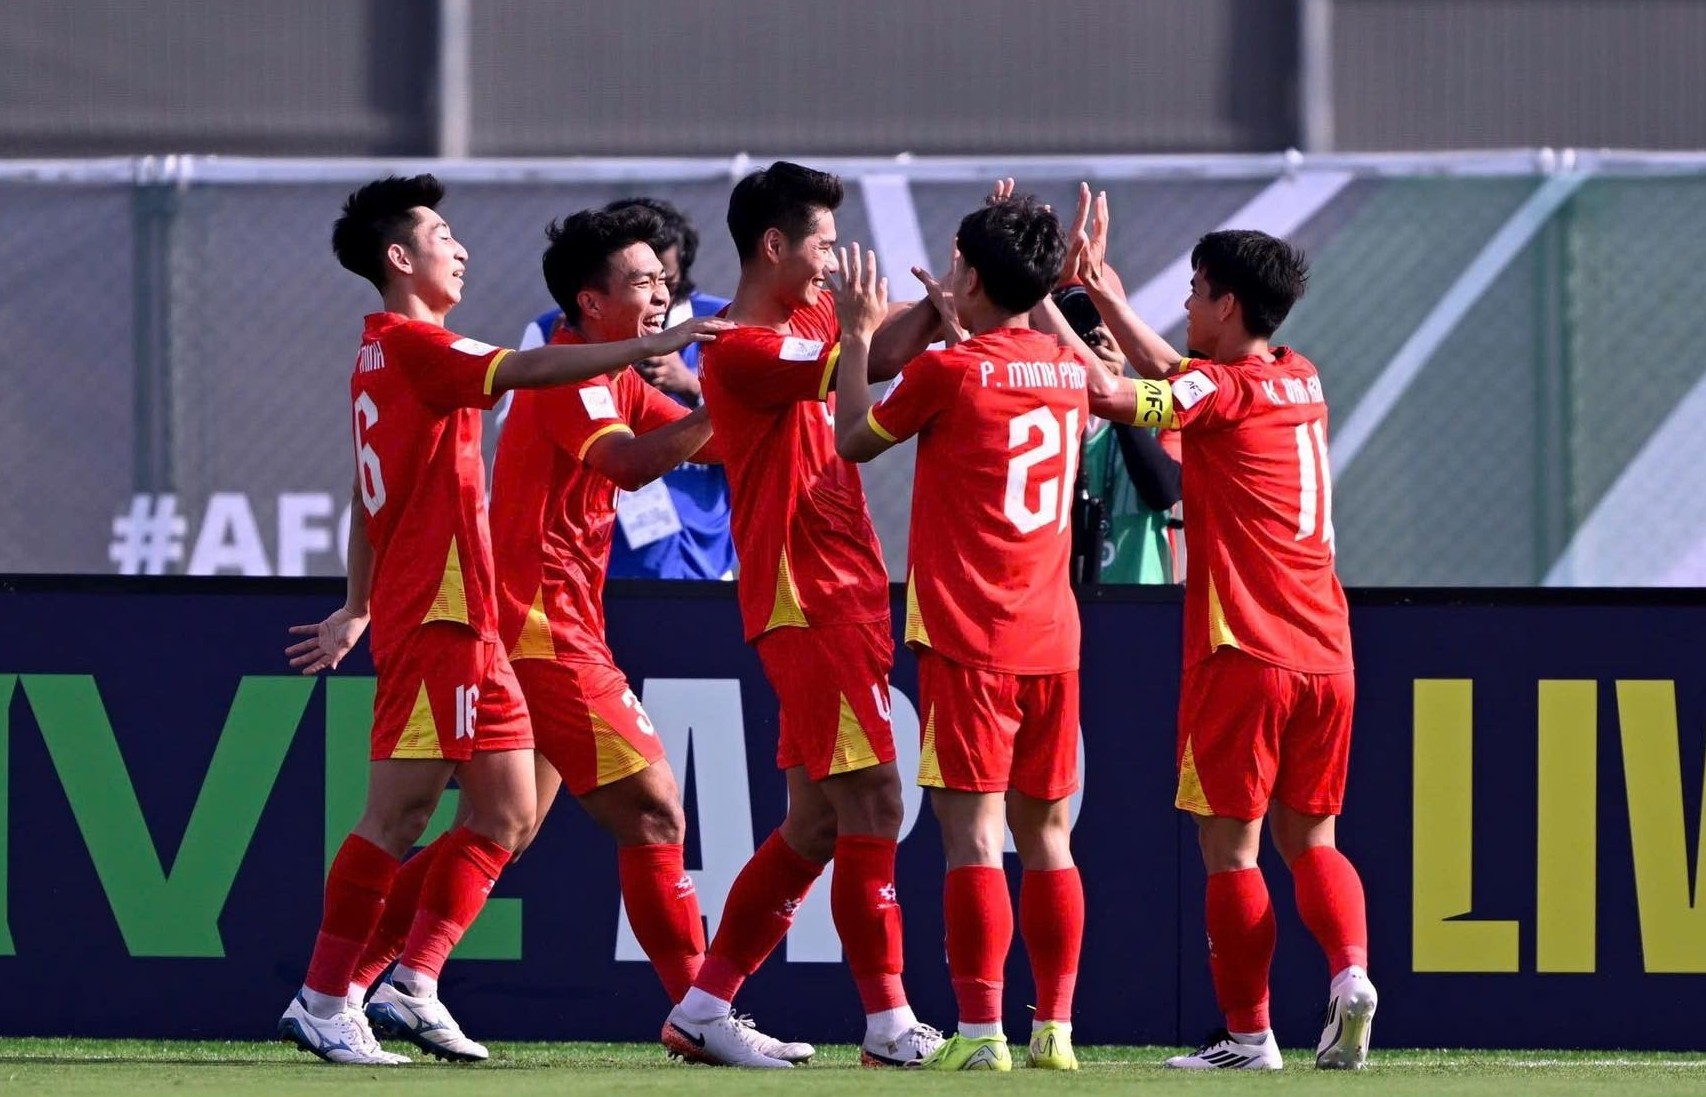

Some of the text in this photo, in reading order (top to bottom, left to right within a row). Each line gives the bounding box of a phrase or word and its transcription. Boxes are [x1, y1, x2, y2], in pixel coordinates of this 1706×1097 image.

[980, 360, 1002, 388] P.
[1007, 361, 1058, 389] MINH
[1261, 379, 1286, 406] K.
[1142, 380, 1164, 423] AFC
[1003, 404, 1080, 535] 21
[1294, 418, 1335, 545] 11
[109, 491, 350, 576] #AF
[456, 683, 480, 740] 16
[621, 688, 654, 735] 3
